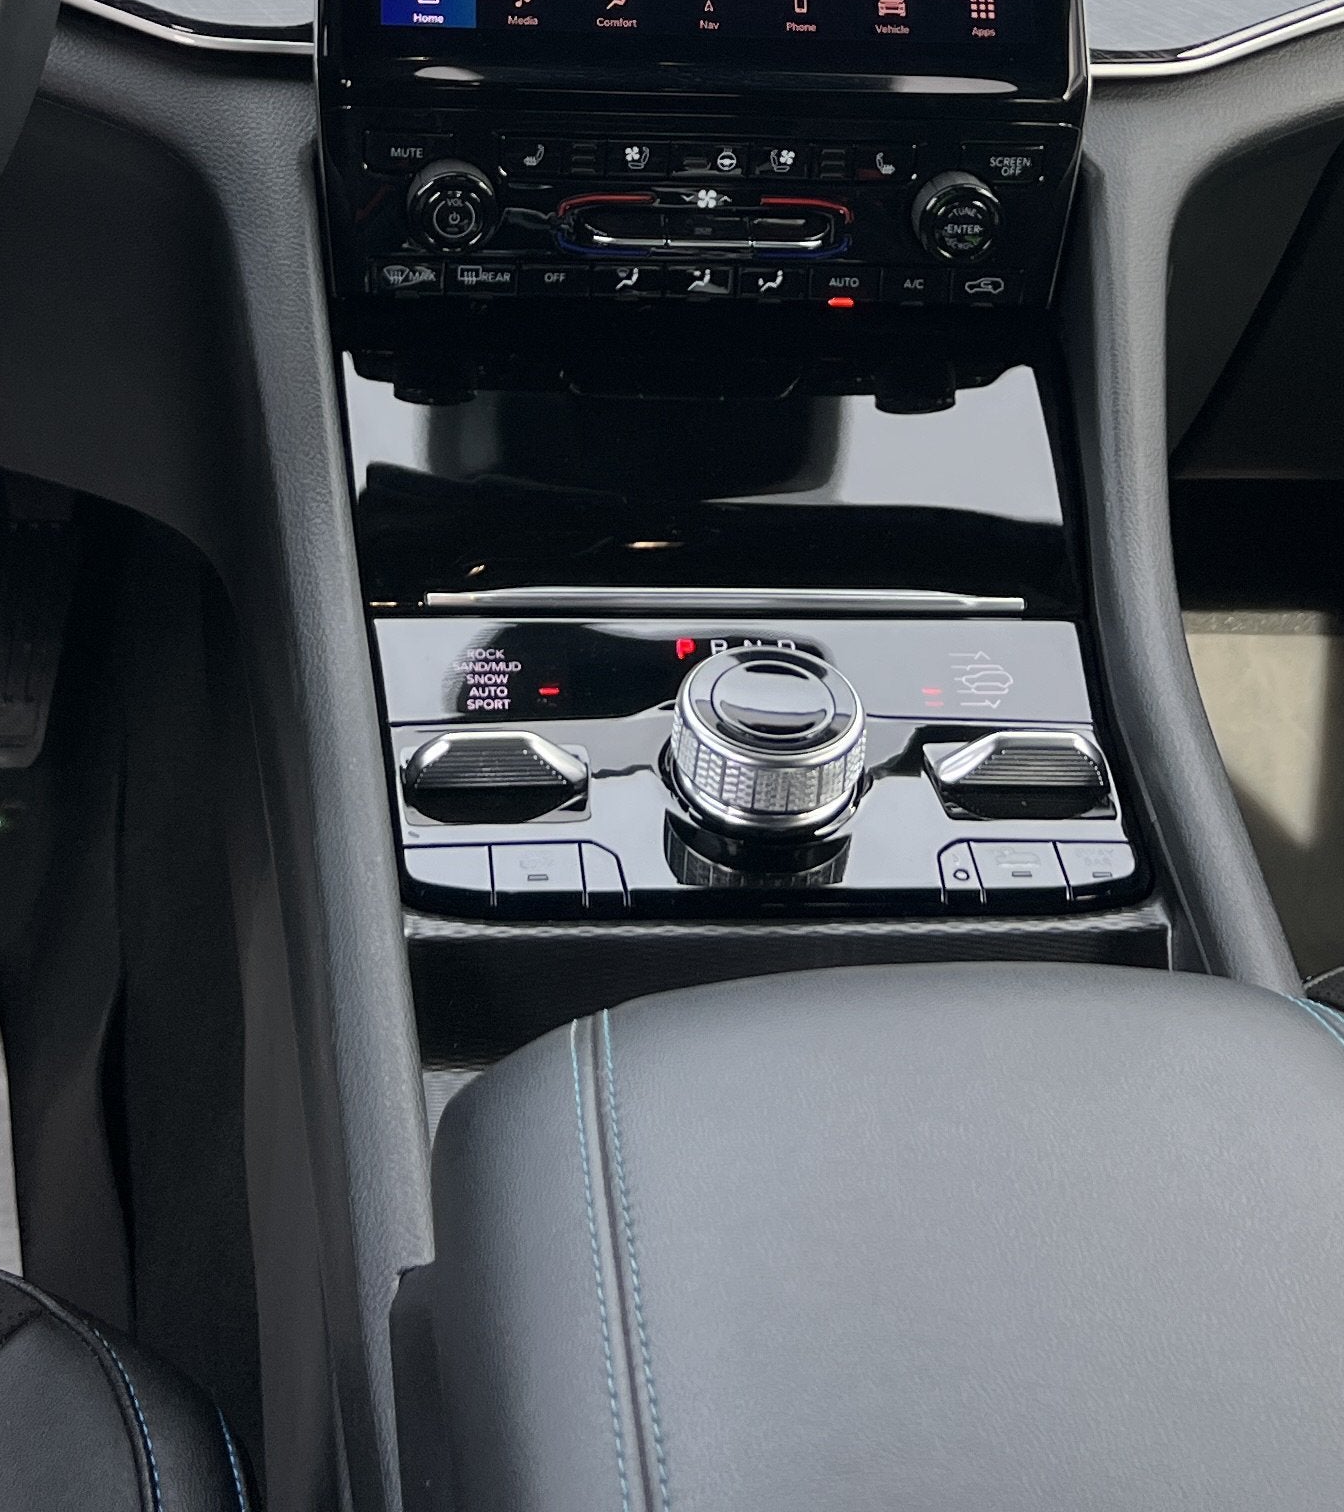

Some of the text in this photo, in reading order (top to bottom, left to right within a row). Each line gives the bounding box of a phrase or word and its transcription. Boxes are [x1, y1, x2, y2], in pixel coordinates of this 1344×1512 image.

[413, 13, 445, 24] Home
[507, 15, 539, 26] Media
[596, 17, 638, 29] Comfort
[699, 19, 720, 31] Nav
[786, 21, 817, 33] Phone
[874, 24, 910, 35] Vehicle
[971, 26, 997, 38] Apps
[390, 147, 424, 159] MUTE
[989, 156, 1032, 169] SCREEN
[1000, 166, 1023, 177] OFF
[446, 197, 464, 208] VOL
[947, 223, 980, 235] ENTER
[408, 270, 437, 283] MAX
[480, 271, 511, 283] REAR
[543, 272, 566, 284] OFF
[828, 277, 860, 288] AUTO
[903, 278, 925, 290] A/C
[465, 647, 505, 660] ROCK
[674, 637, 697, 661] P
[465, 672, 509, 685] SNOW
[468, 686, 508, 698] AUTO
[465, 698, 512, 711] SPORT
